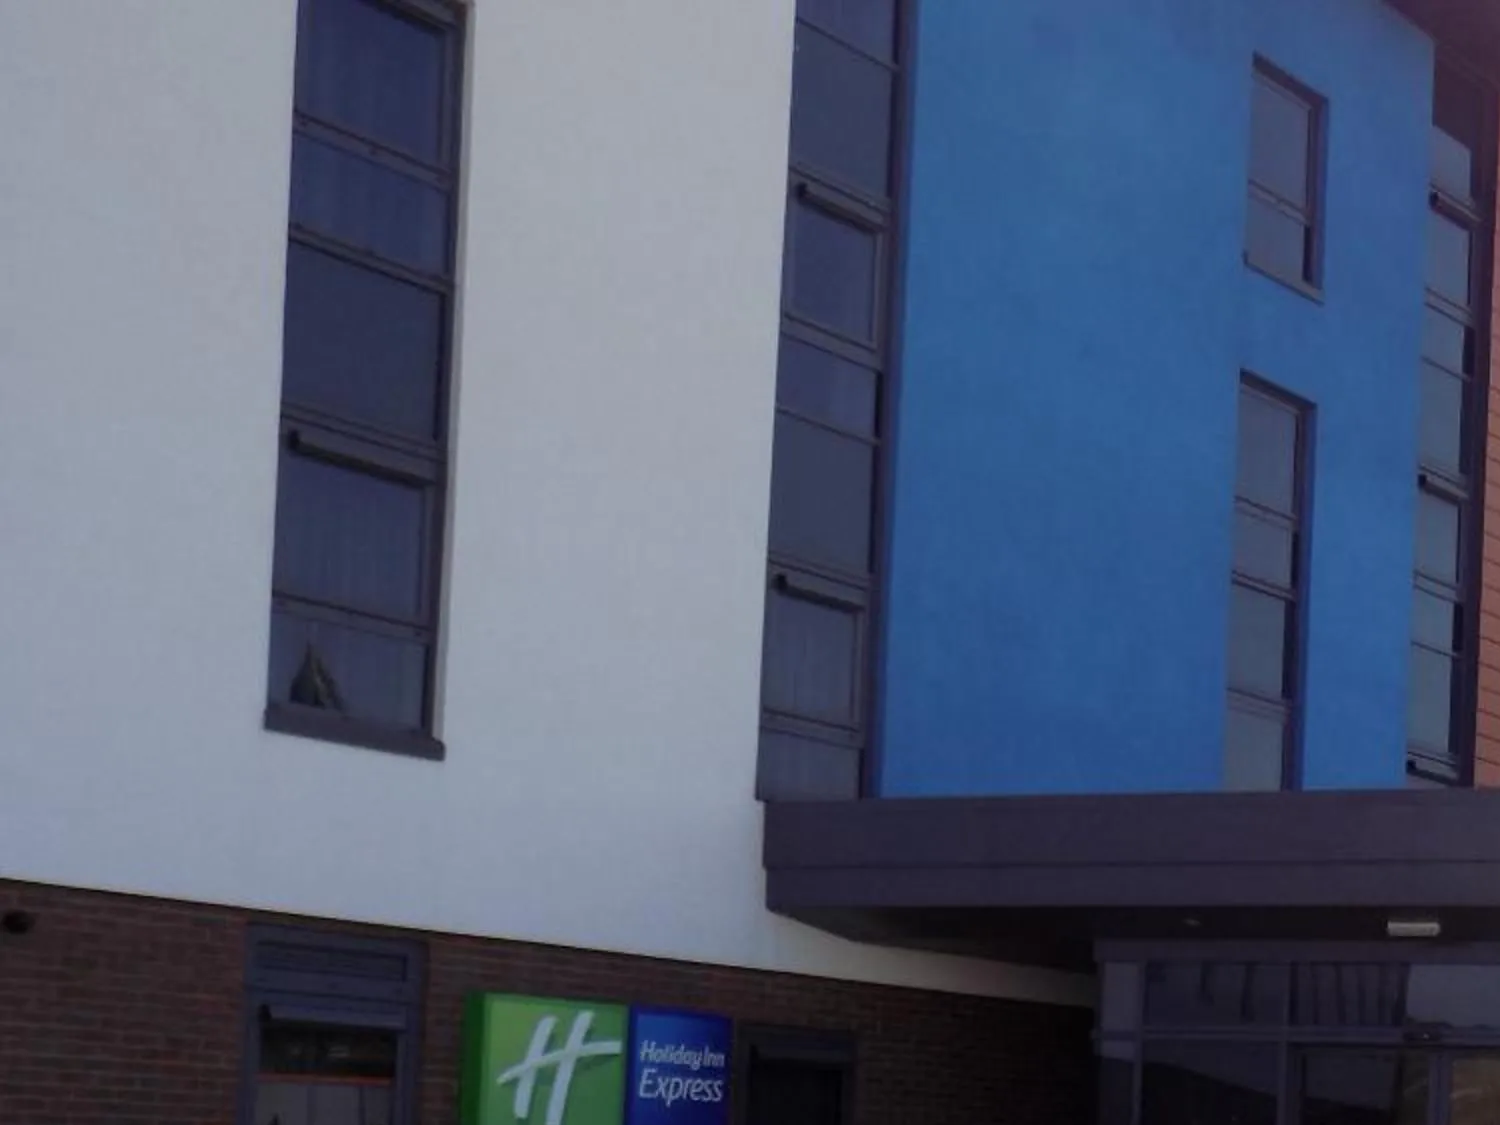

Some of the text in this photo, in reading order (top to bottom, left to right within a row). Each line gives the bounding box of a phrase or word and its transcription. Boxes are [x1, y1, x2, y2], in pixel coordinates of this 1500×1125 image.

[640, 1039, 725, 1071] Holiday Inn
[639, 1068, 724, 1107] Express
